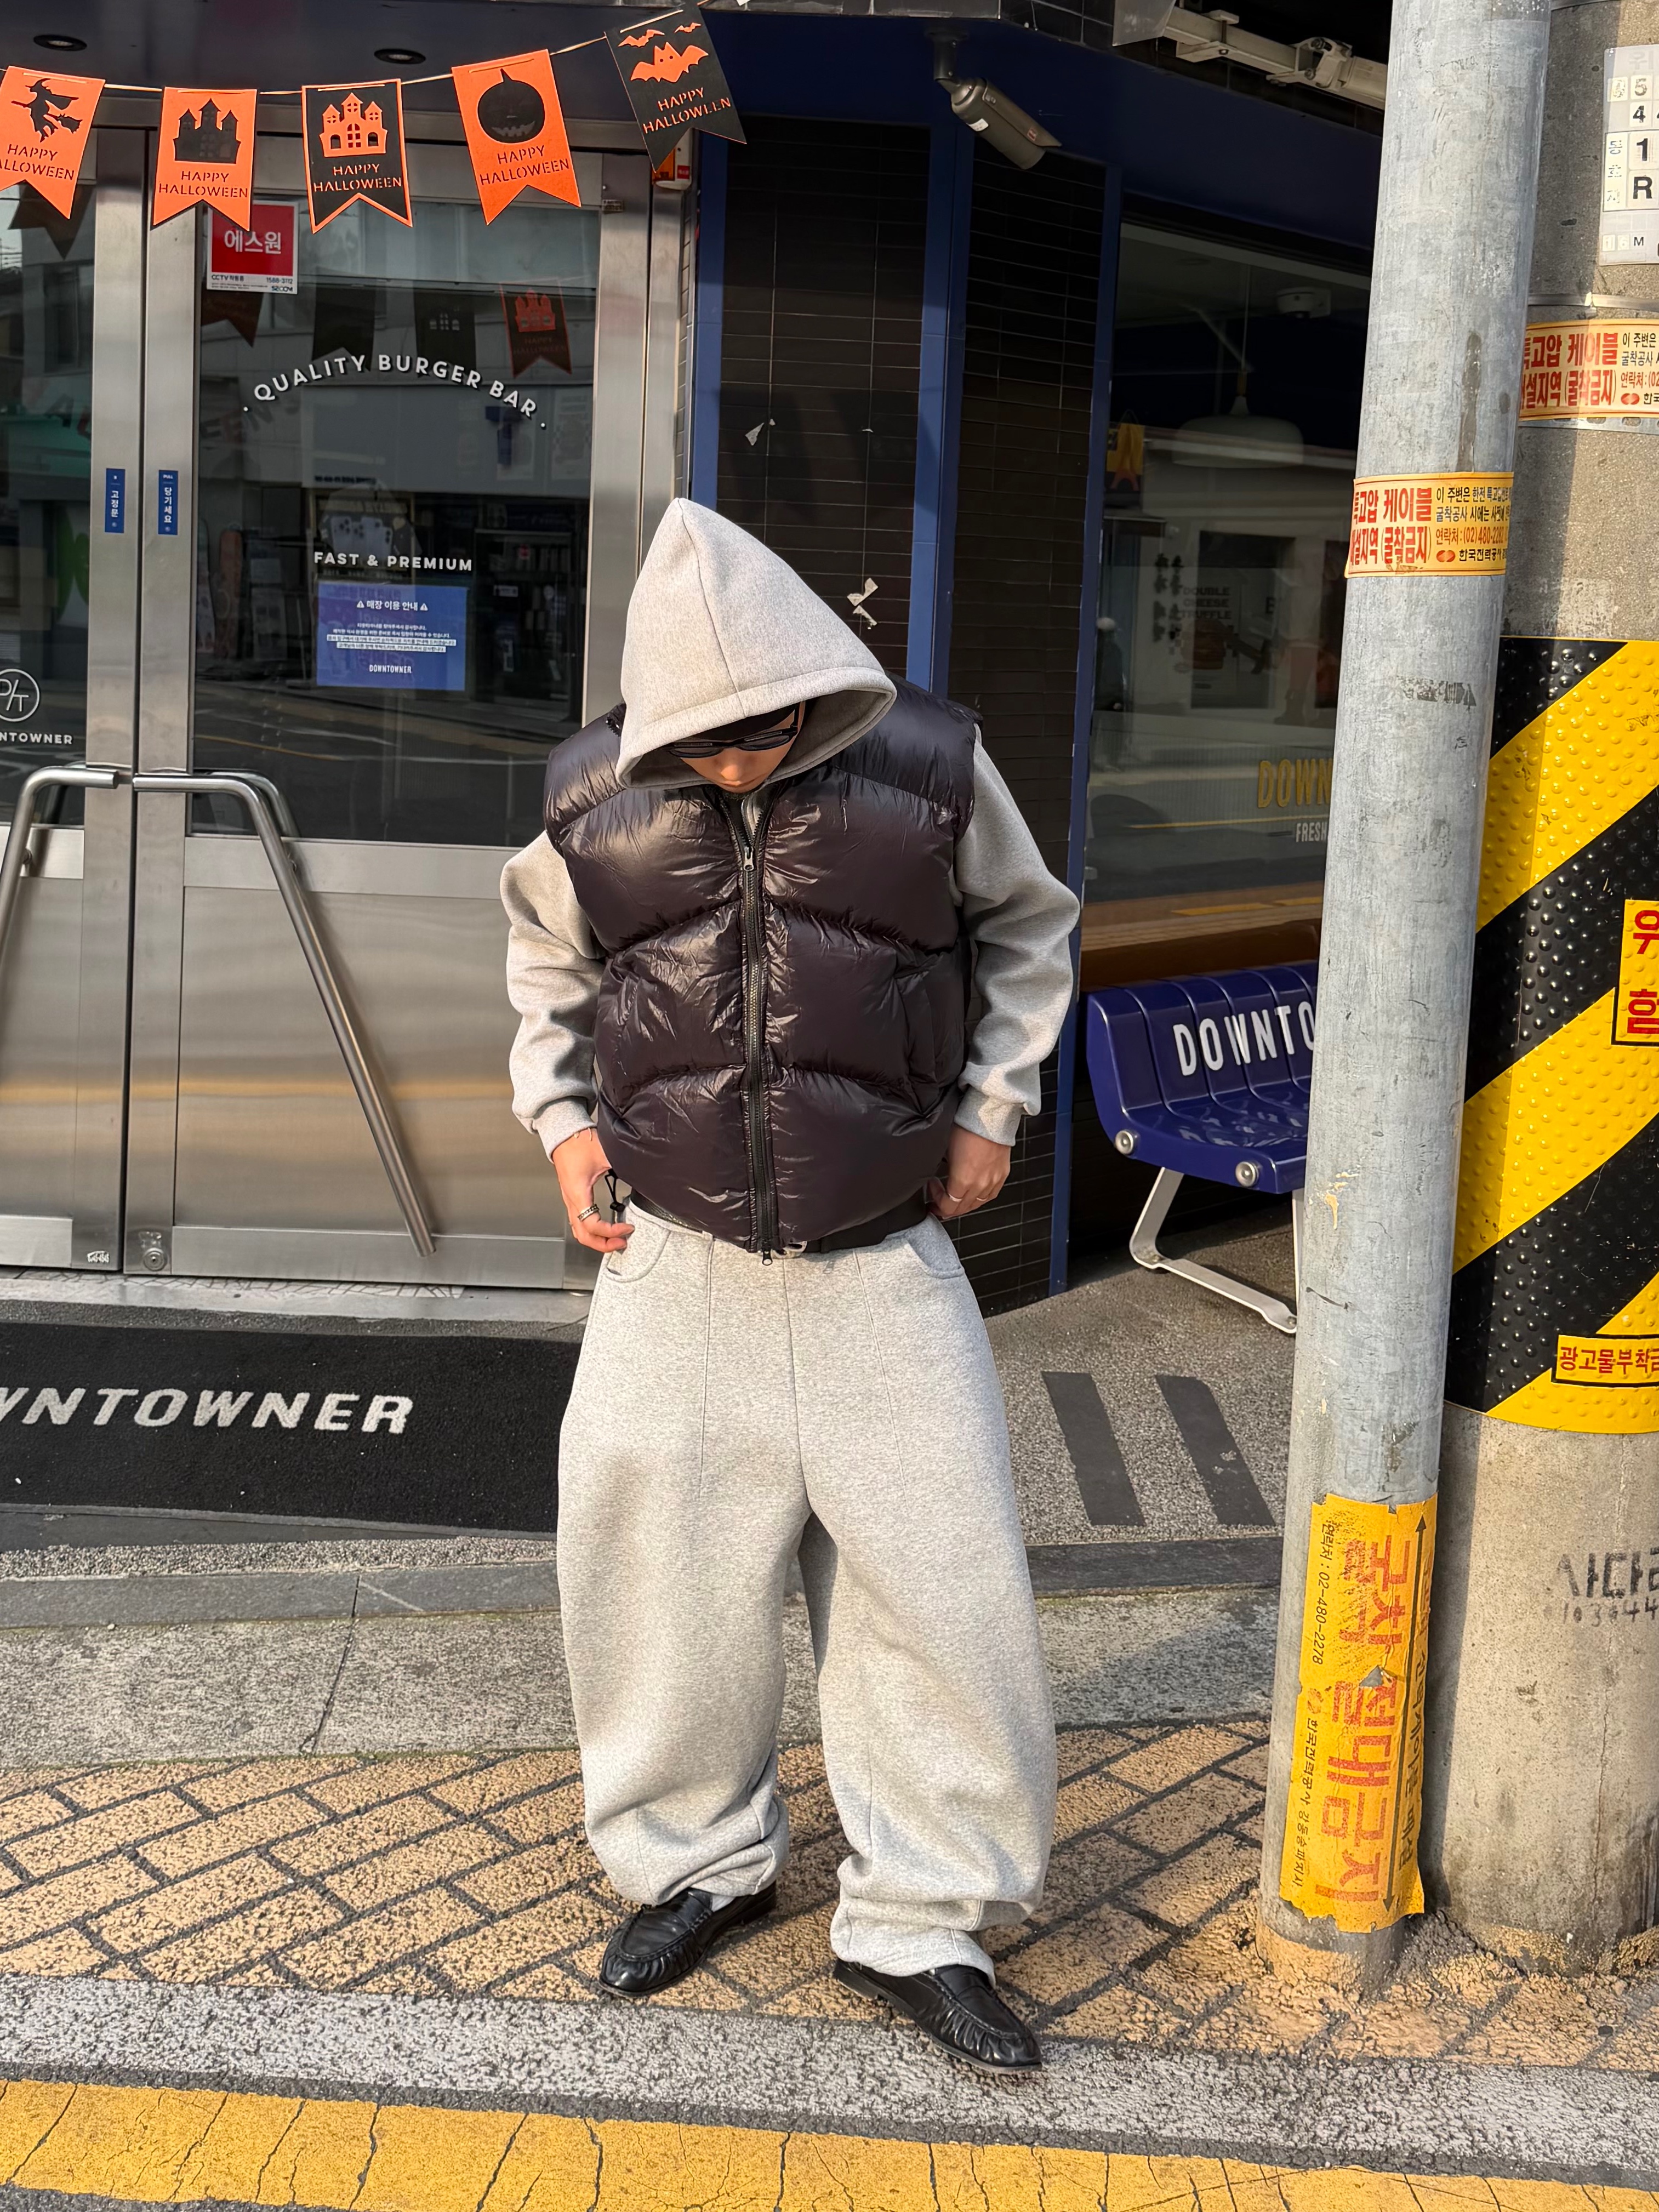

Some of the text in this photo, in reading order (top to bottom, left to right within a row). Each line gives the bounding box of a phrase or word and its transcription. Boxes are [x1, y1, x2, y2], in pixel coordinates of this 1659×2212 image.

[658, 87, 705, 112] HAPPY
[642, 97, 732, 134] HALLOWEEN
[8, 144, 58, 161] HAPPY
[497, 145, 545, 164] HAPPY
[0, 158, 75, 180] LLOWEEN
[181, 170, 230, 183] HAPPY
[332, 163, 381, 176] HAPPY
[479, 158, 570, 186] HALLOWEEN
[158, 183, 249, 198] HALLOWEEN
[313, 177, 403, 192] HALLOWEEN
[1633, 176, 1653, 199] R
[224, 229, 282, 254] 에스원
[1633, 236, 1644, 246] M
[1524, 332, 1656, 370] 특고압 케이블 이 주변은
[1621, 350, 1653, 367] 굴착공사
[254, 354, 537, 417] QUALITY BURGER BAR
[164, 487, 172, 523] 당기세요
[1353, 489, 1379, 525] 특고압
[1383, 487, 1433, 523] 케이블
[1436, 486, 1445, 501] 이
[1447, 486, 1470, 504] 주변은
[1436, 506, 1468, 522] 굴착공사
[1470, 505, 1490, 522] 시에는
[314, 551, 472, 571] FAST & PREMIUM
[366, 600, 418, 611] 매장 이용 안내
[369, 664, 412, 674] DOWNTOWNER
[1257, 758, 1333, 808] DOWN
[1295, 822, 1327, 842] FRESH
[1173, 1001, 1315, 1076] DOWNTO
[1299, 1717, 1318, 1806] 한국전력공사
